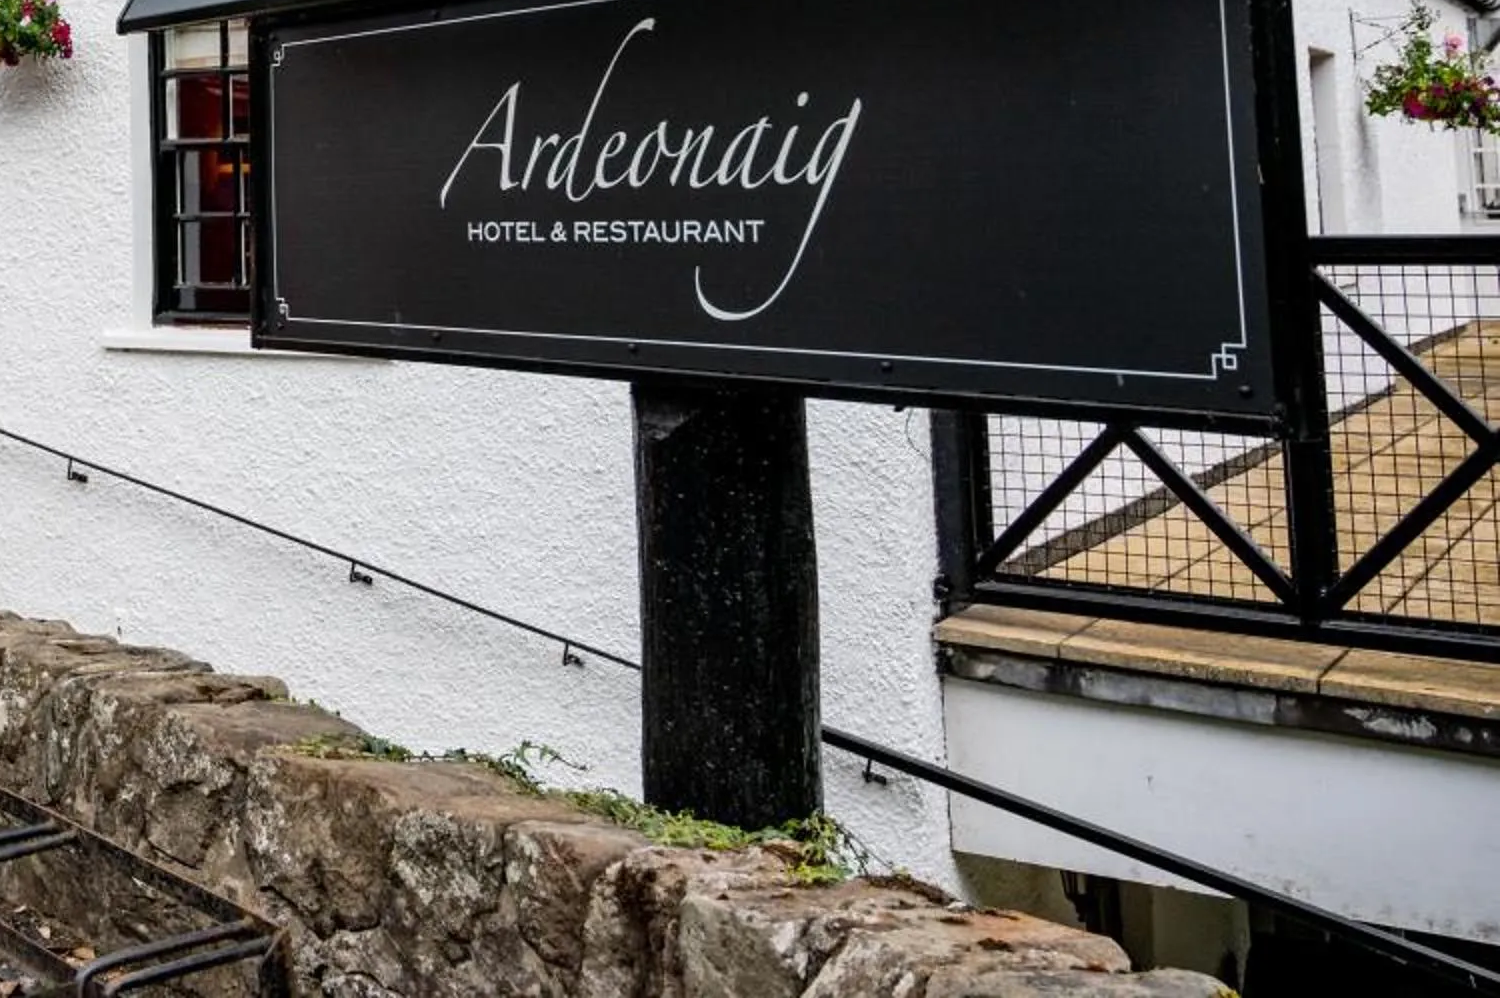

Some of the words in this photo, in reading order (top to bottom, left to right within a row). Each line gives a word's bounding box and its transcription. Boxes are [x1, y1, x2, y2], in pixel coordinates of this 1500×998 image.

[440, 17, 862, 321] Ardeonaig
[467, 221, 546, 242] HOTEL
[550, 221, 567, 242] &
[573, 220, 765, 243] RESTAURANT
